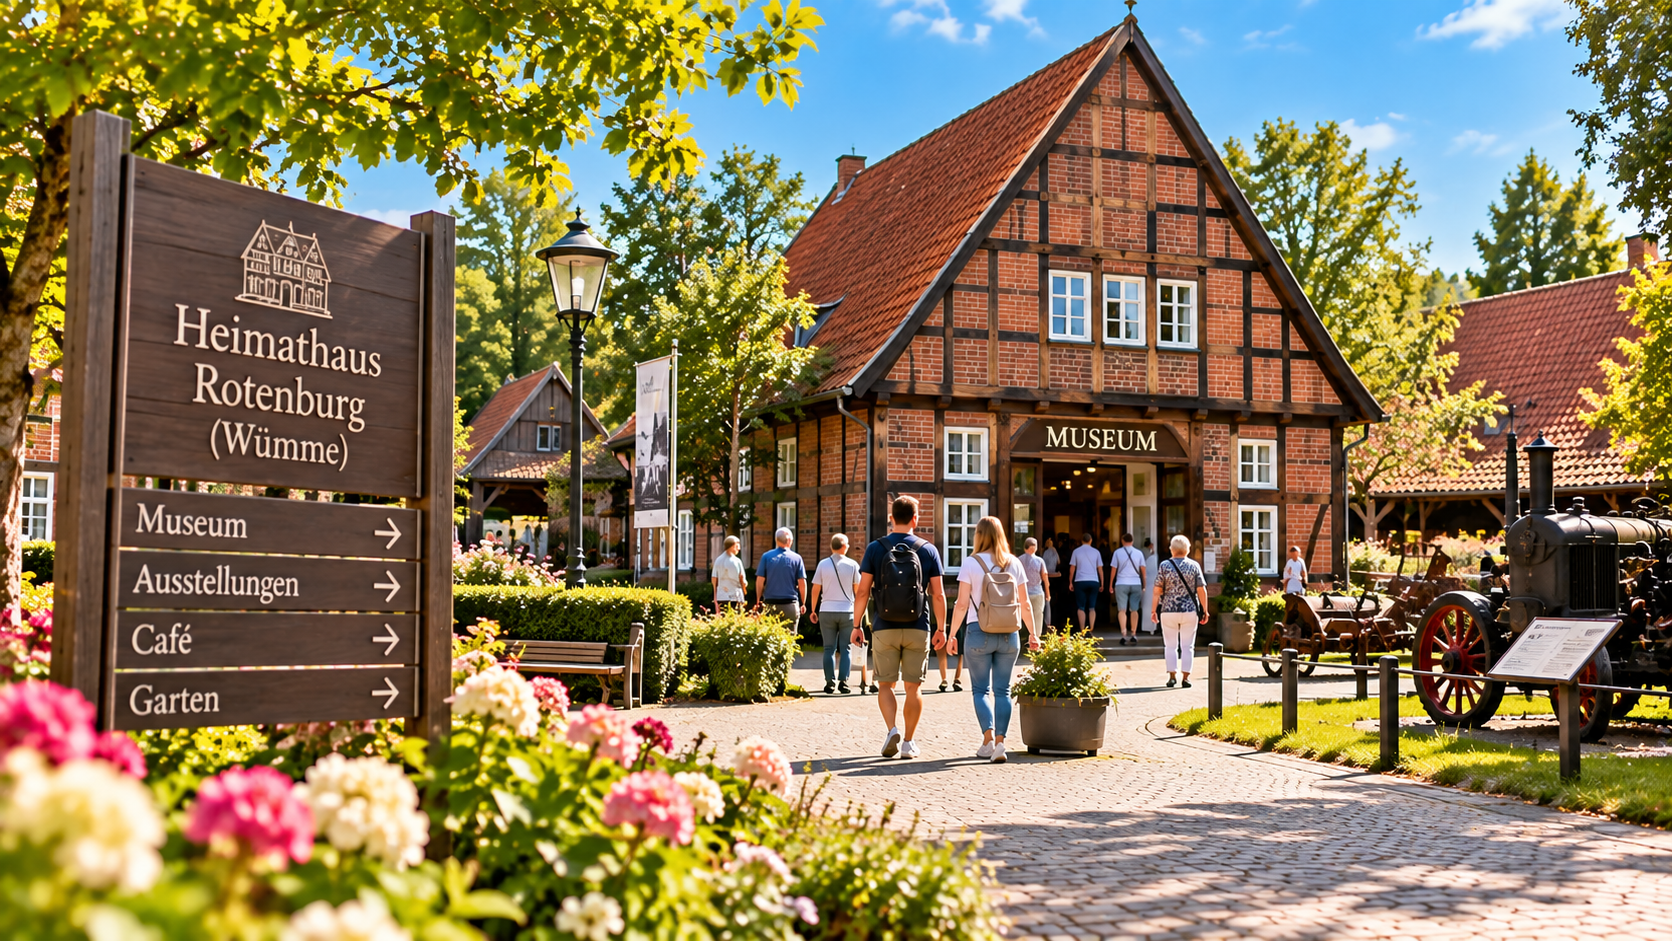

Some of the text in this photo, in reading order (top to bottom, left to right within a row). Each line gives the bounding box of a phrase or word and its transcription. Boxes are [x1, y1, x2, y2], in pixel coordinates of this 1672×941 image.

[173, 303, 382, 377] Heimathaus
[192, 362, 366, 433] Rotenburg
[210, 418, 349, 472] (Wümme)
[1045, 425, 1158, 452] MUSEUM
[135, 503, 248, 539] Museum
[132, 564, 299, 605] Ausstellungen
[131, 622, 193, 655] Café
[129, 684, 220, 716] Garten
